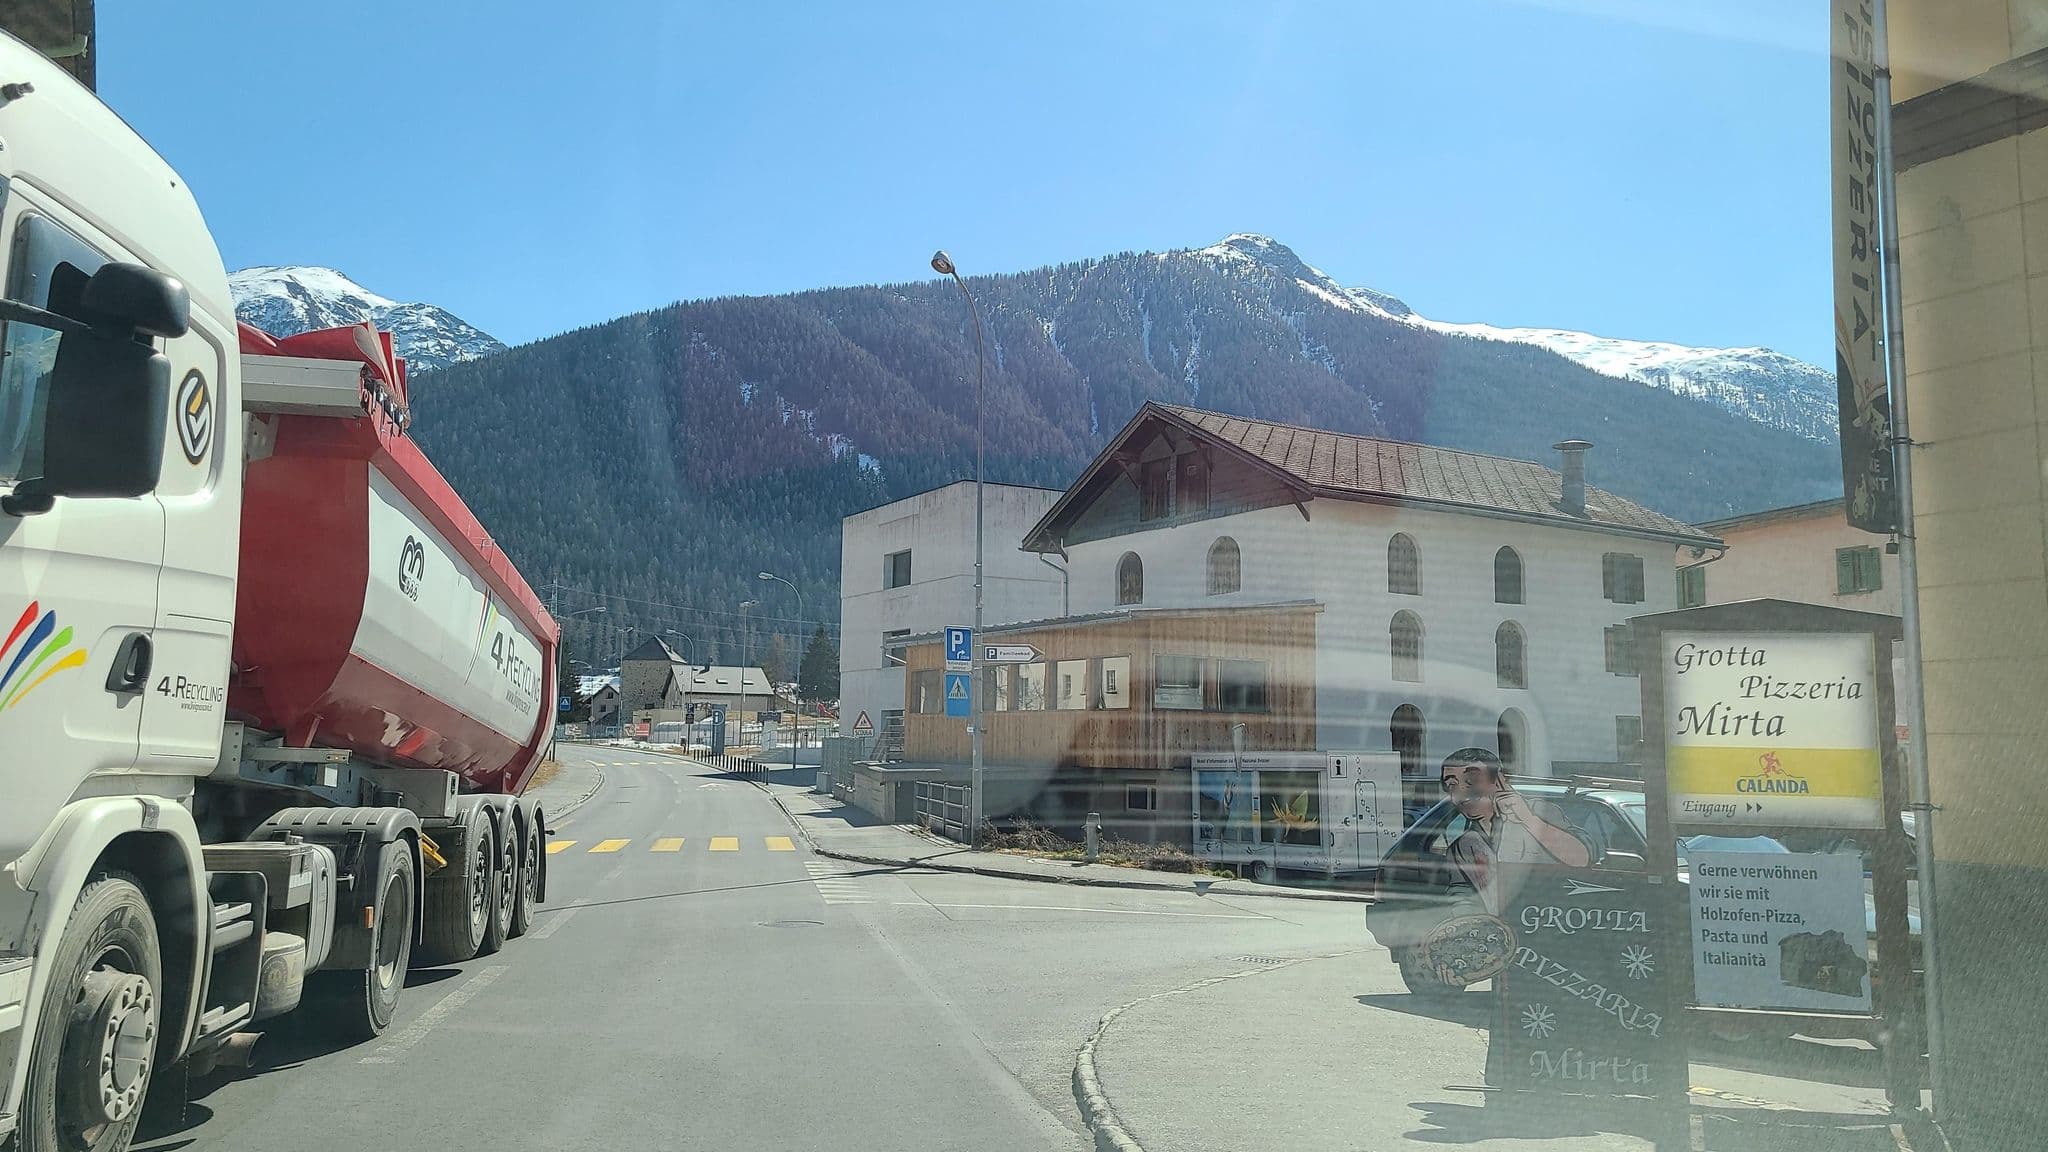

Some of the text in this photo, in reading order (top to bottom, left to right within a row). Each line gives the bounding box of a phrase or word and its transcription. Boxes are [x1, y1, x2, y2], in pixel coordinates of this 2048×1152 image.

[1844, 12, 1869, 342] PIZZERIA
[951, 630, 963, 652] P
[1674, 643, 1767, 674] Grotta
[1739, 675, 1863, 700] Pizzeria
[1677, 701, 1786, 737] Mirta
[1736, 779, 1810, 794] CALANDA
[1682, 800, 1737, 817] Eingang
[1698, 863, 1818, 880] Gerne verwöhnen
[1698, 886, 1770, 901] wir sie mit
[1521, 905, 1651, 935] GROTTA
[1700, 906, 1806, 926] Holzofen-Pizza,
[1702, 929, 1769, 945] Pasta und
[1703, 951, 1766, 967] Italianità
[1515, 946, 1663, 1038] PIZZARIA
[1529, 1048, 1653, 1085] Mirta
